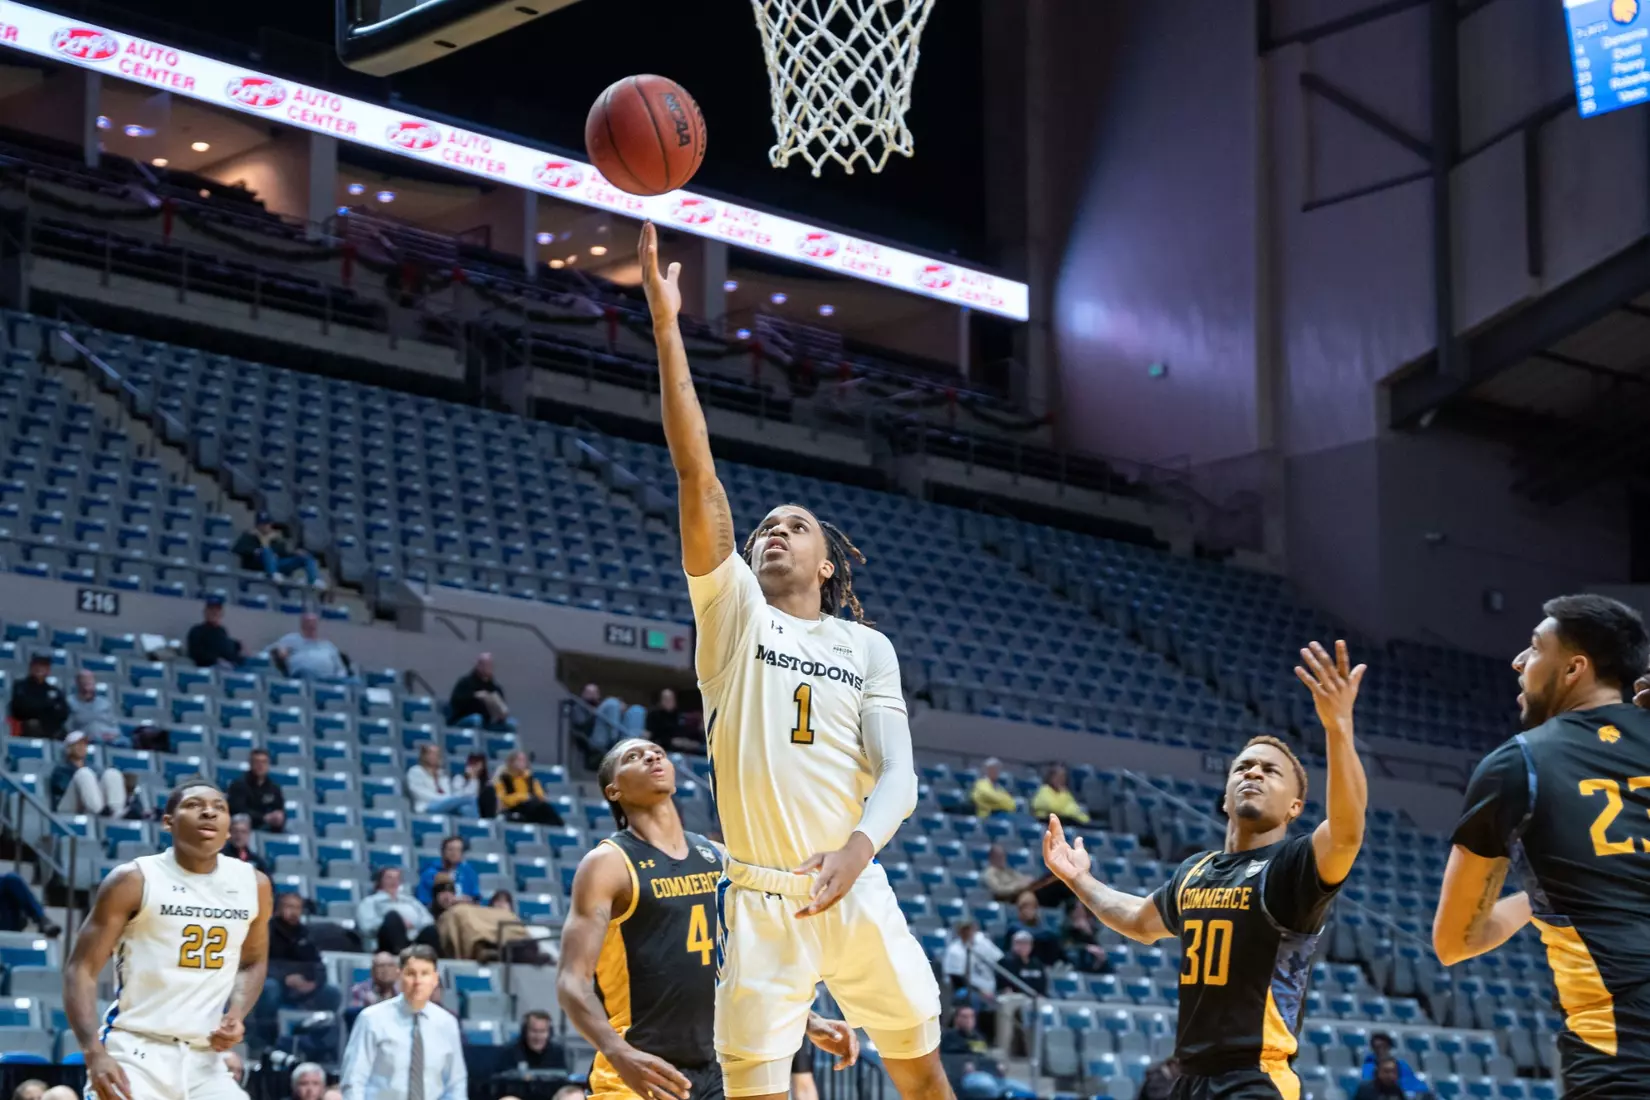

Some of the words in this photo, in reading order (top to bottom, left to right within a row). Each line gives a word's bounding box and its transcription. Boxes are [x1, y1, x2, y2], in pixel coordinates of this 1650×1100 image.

[124, 40, 180, 67] AUTO
[118, 58, 196, 91] CENTER
[292, 88, 343, 113] AUTO
[286, 105, 358, 136] CENTER
[447, 131, 493, 154] AUTO
[441, 147, 507, 176] CENTER
[82, 590, 116, 613] 216
[755, 644, 863, 691] MASTODONS
[791, 682, 814, 744] 1
[160, 904, 249, 920] MASTODONS
[1182, 887, 1252, 910] COMMERCE
[178, 924, 228, 969] 22
[686, 904, 714, 966] 4
[1180, 919, 1233, 986] 30
